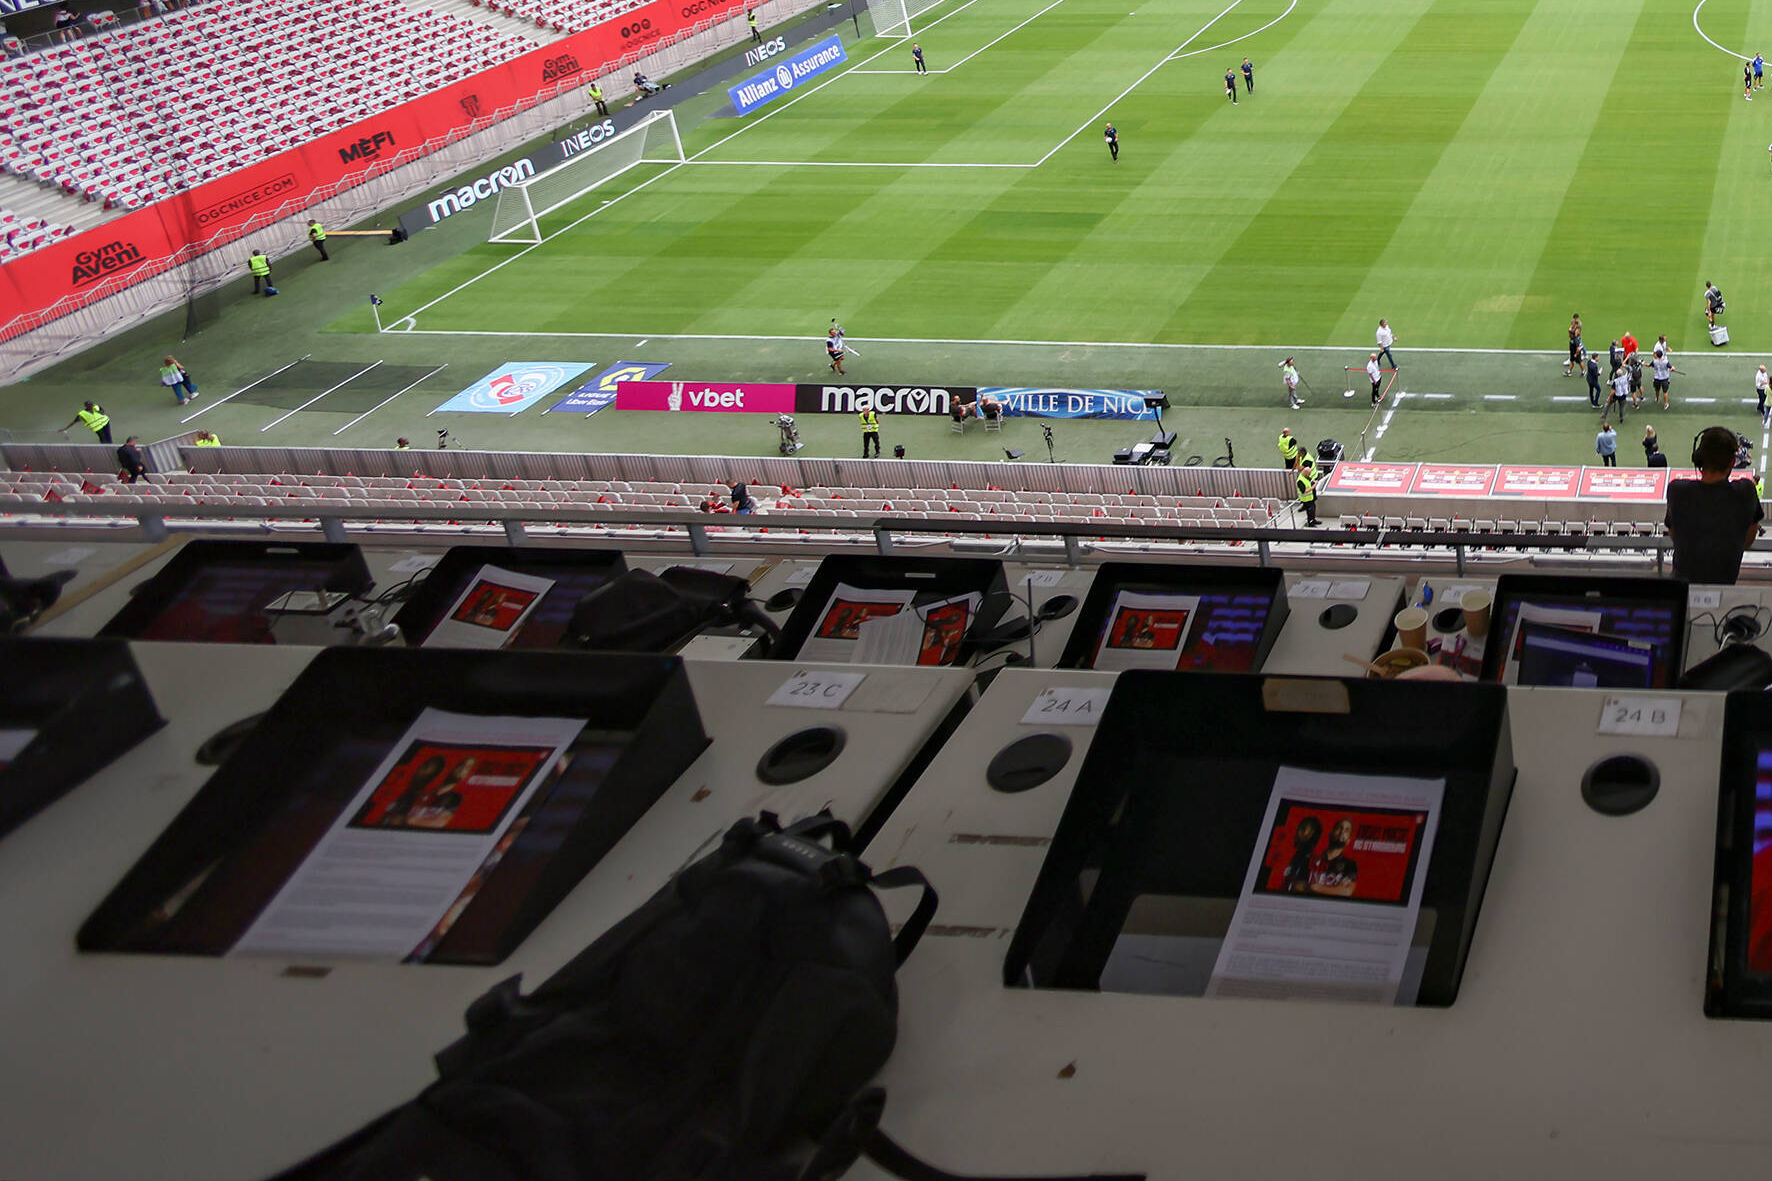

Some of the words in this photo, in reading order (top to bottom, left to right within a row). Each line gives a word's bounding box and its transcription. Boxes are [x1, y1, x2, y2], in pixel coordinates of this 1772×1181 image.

[682, 0, 709, 19] OGC
[544, 54, 570, 69] Gym
[744, 36, 786, 67] INEOS
[736, 77, 778, 107] Allianz
[791, 43, 841, 78] Assurance
[338, 131, 396, 164] MÈFI
[560, 119, 616, 158] INEOS
[197, 178, 294, 224] OGCNICE.COM
[426, 158, 536, 223] macron
[76, 241, 123, 266] Gym
[689, 387, 744, 409] vbet
[821, 387, 950, 414] macron
[1004, 394, 1059, 413] VILLE
[1067, 396, 1095, 413] DE
[790, 683, 821, 697] 23
[824, 684, 843, 698] C
[1041, 699, 1072, 713] 24
[1074, 699, 1092, 713] A
[1615, 709, 1642, 723] 24
[1651, 709, 1666, 724] B
